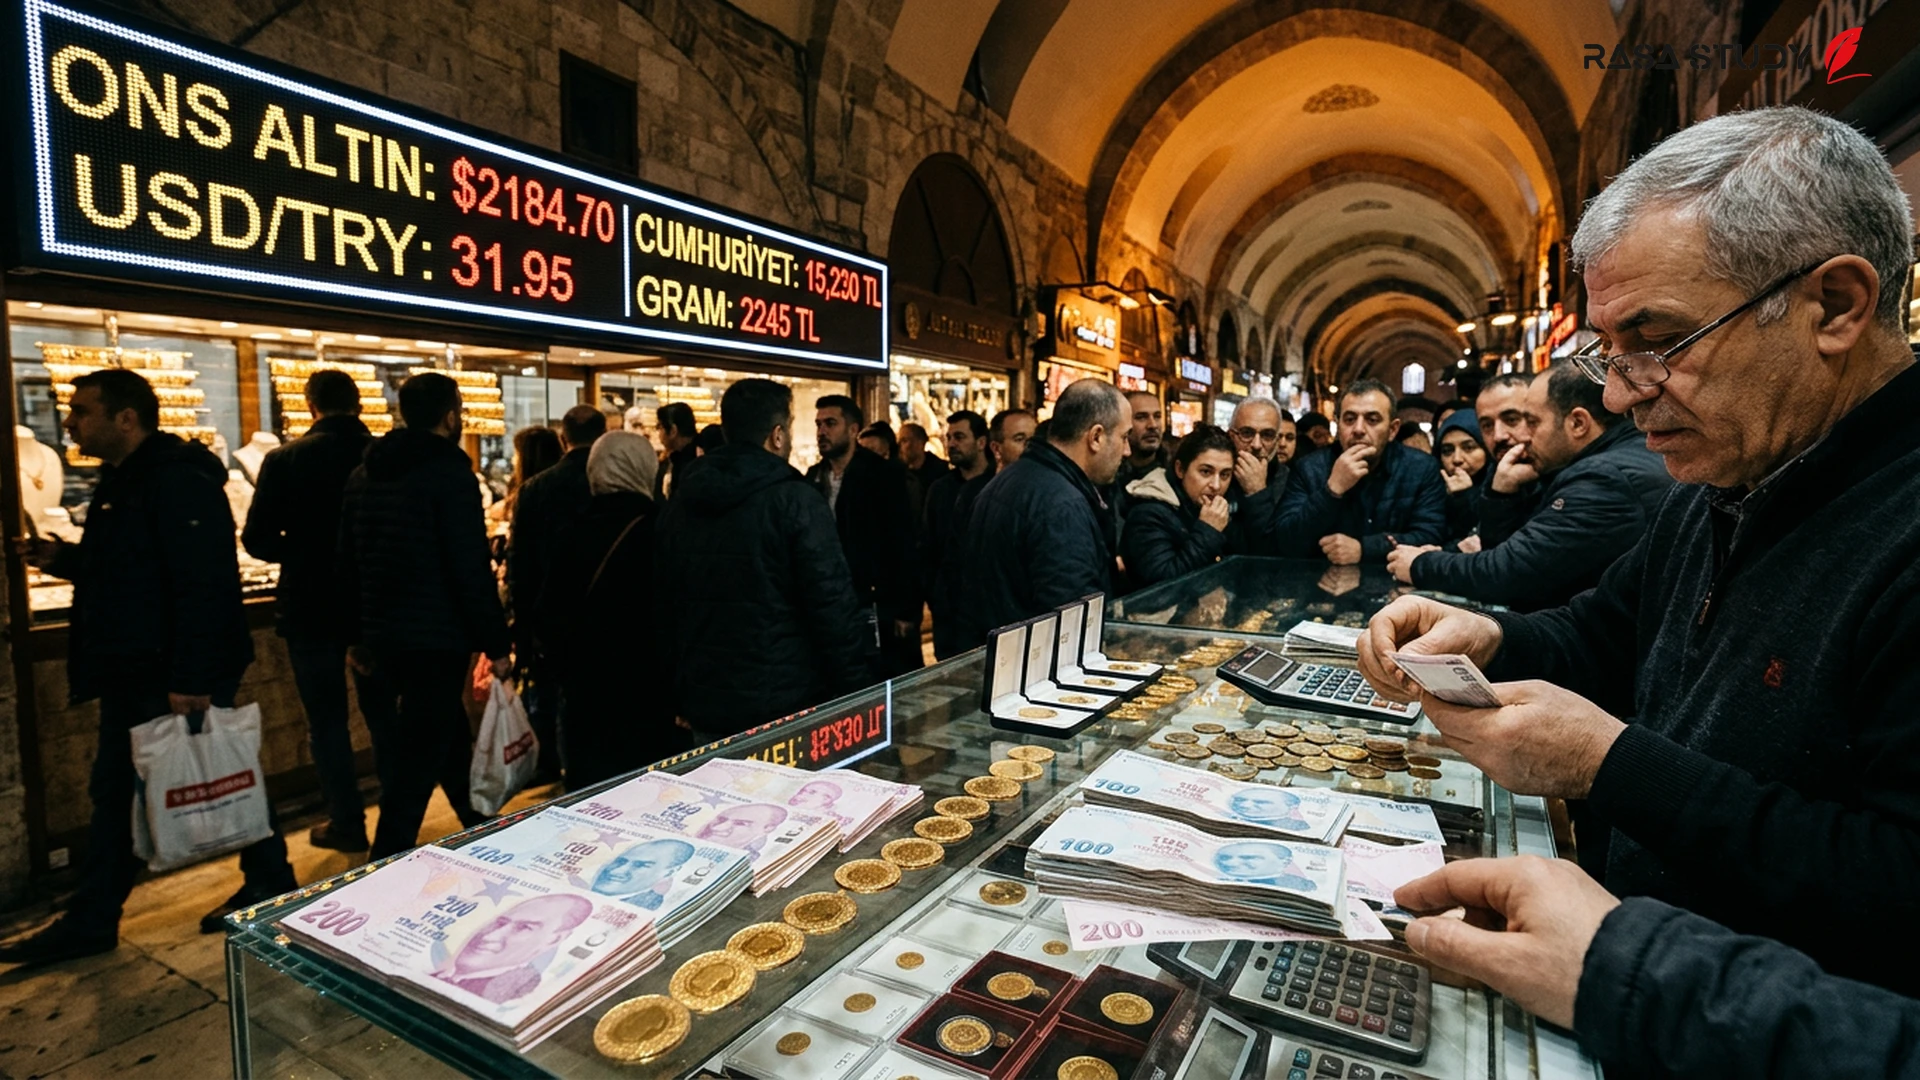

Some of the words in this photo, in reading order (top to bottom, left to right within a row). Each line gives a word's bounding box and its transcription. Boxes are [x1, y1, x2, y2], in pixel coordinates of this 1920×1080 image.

[52, 45, 233, 150] ONS
[253, 104, 436, 202] ALTIN:
[451, 156, 615, 243] $2184.70
[75, 154, 432, 282] USD/TRY:
[451, 235, 575, 303] 31.95
[635, 213, 799, 289] CUMHURİYET:
[805, 260, 860, 303] 15,230
[863, 275, 882, 309] TL
[637, 275, 734, 329] GRAM:
[740, 297, 791, 338] 2245
[795, 307, 821, 343] TL
[1059, 837, 1114, 855] 100
[299, 900, 370, 937] 200
[1079, 919, 1144, 942] 200
